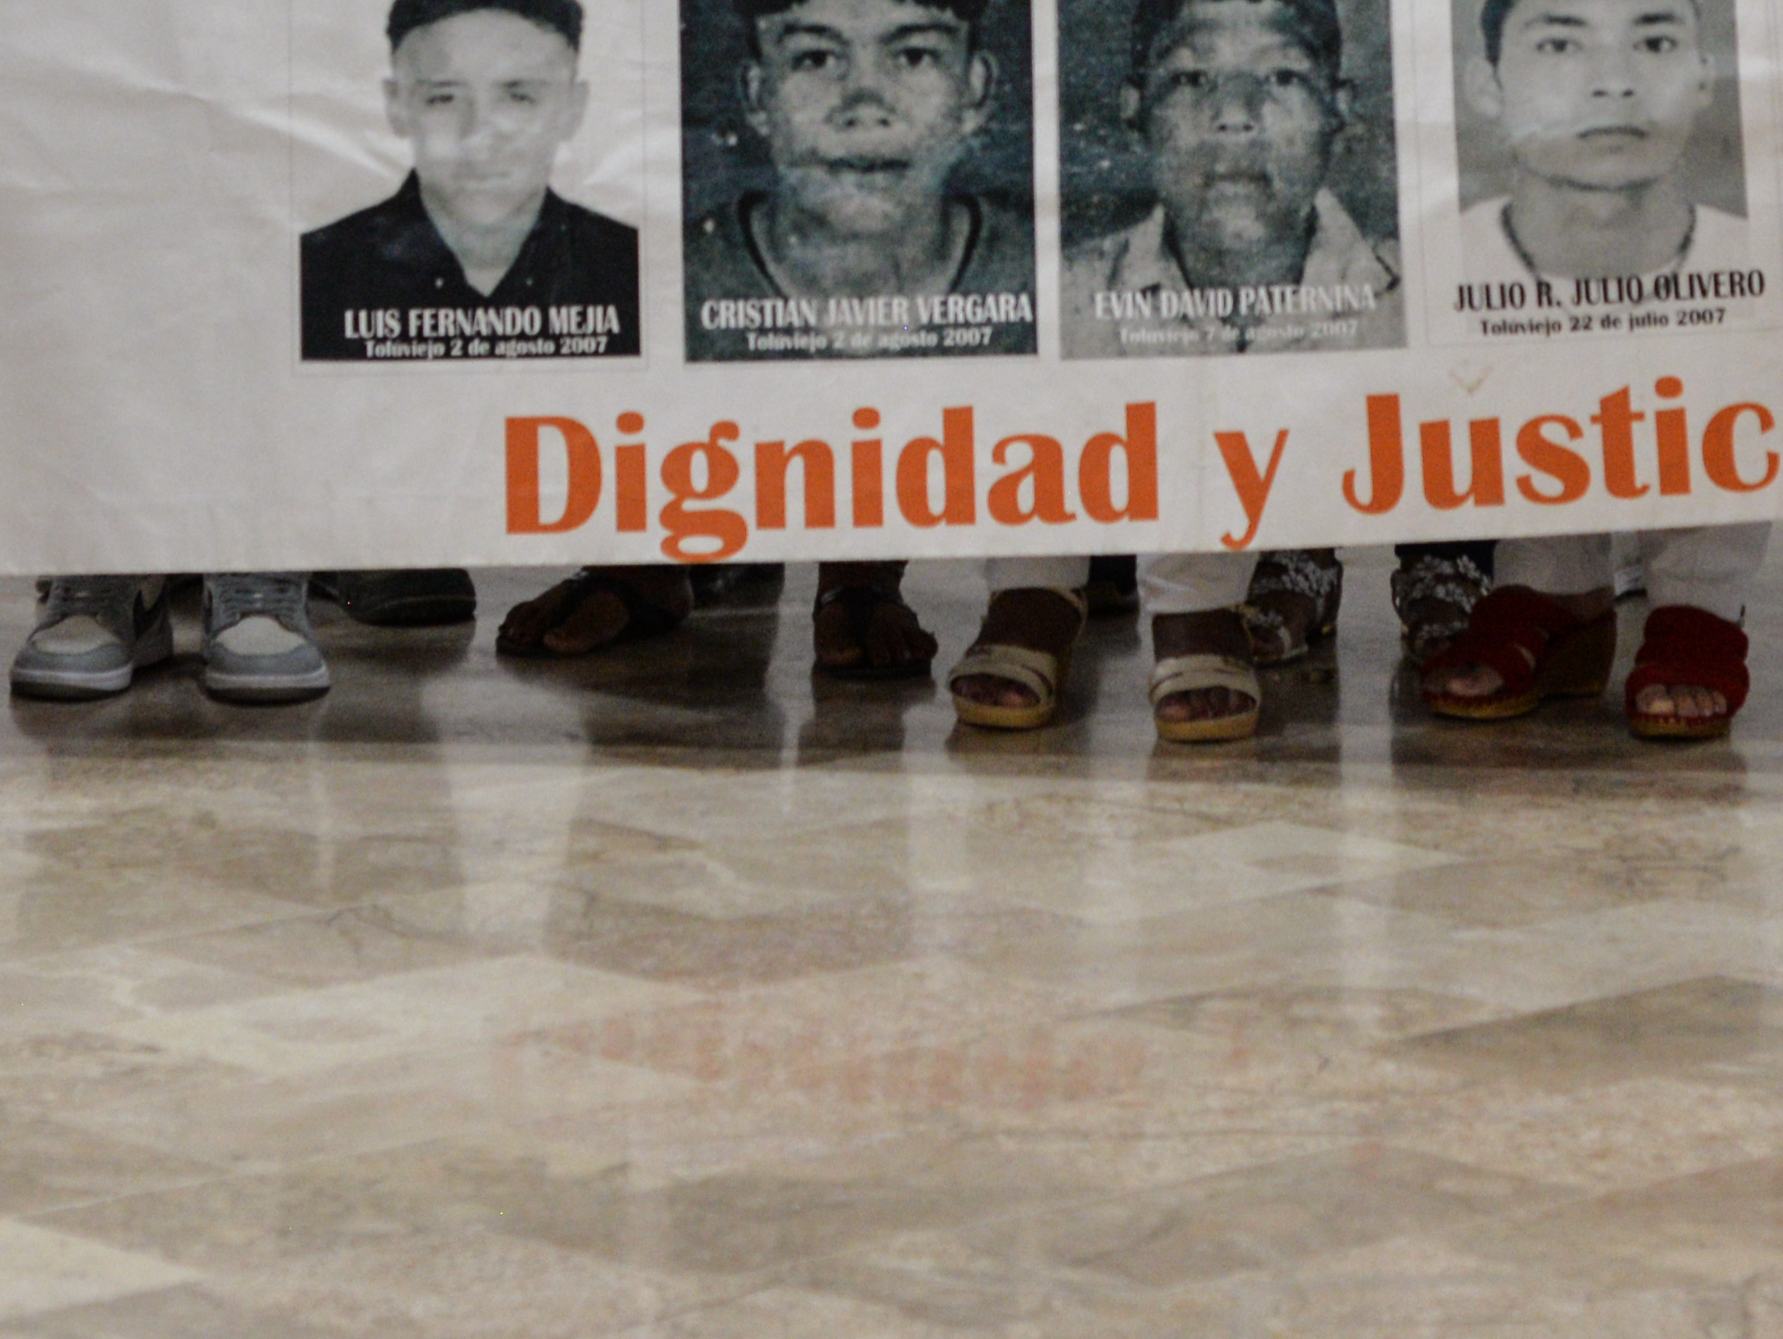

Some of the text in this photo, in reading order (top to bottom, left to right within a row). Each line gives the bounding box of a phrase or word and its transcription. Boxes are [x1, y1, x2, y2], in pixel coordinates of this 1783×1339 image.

[1159, 287, 1233, 320] DAVID
[1239, 284, 1377, 317] PATERNINA
[1454, 269, 1766, 312] JULIO R. JULIO OLIVERO
[344, 304, 621, 340] LUIS FERNANDO MEJIA
[701, 292, 1034, 330] CRISTIAN JAVIER VERGARA
[1480, 308, 1727, 337] Toluviejo 22 de julio 2007
[365, 336, 608, 360] Toluviejo 2 de agosto 2007
[746, 327, 993, 353] Toluviejo 2 de agosto 2007
[503, 401, 1162, 565] Dignidad
[1213, 426, 1290, 552] y
